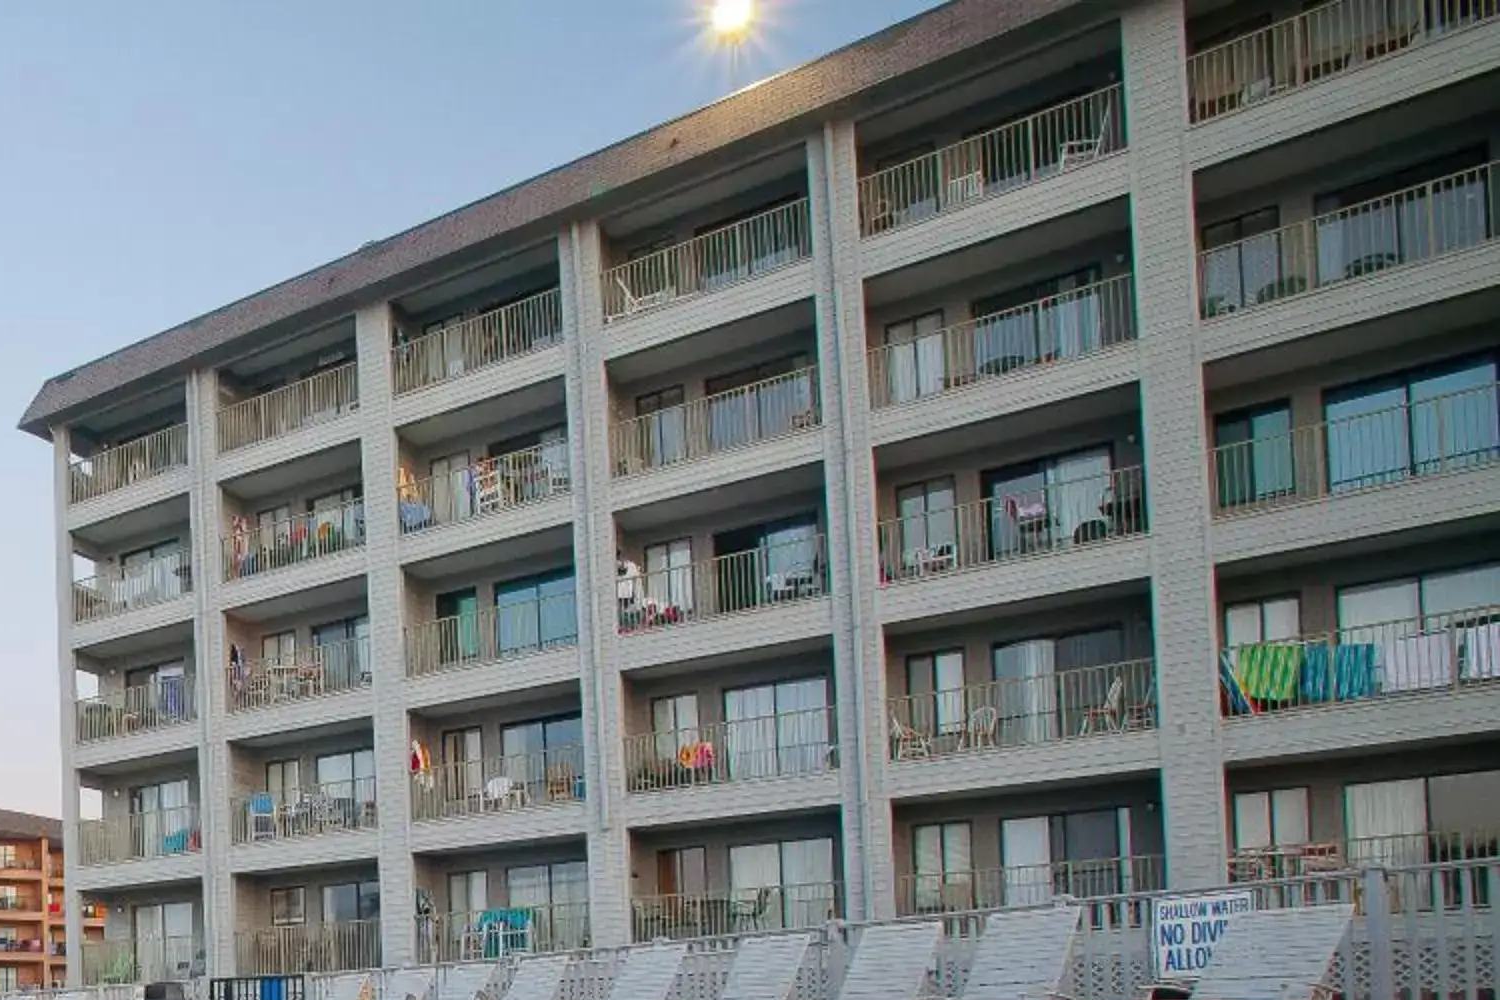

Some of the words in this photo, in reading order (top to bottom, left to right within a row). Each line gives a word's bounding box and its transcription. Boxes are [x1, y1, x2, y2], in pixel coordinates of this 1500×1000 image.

[1160, 902, 1207, 919] SHALLOW
[1211, 898, 1248, 915] WATER
[1161, 924, 1184, 946] NO
[1191, 920, 1228, 944] DIVI
[1165, 947, 1211, 970] ALLO
